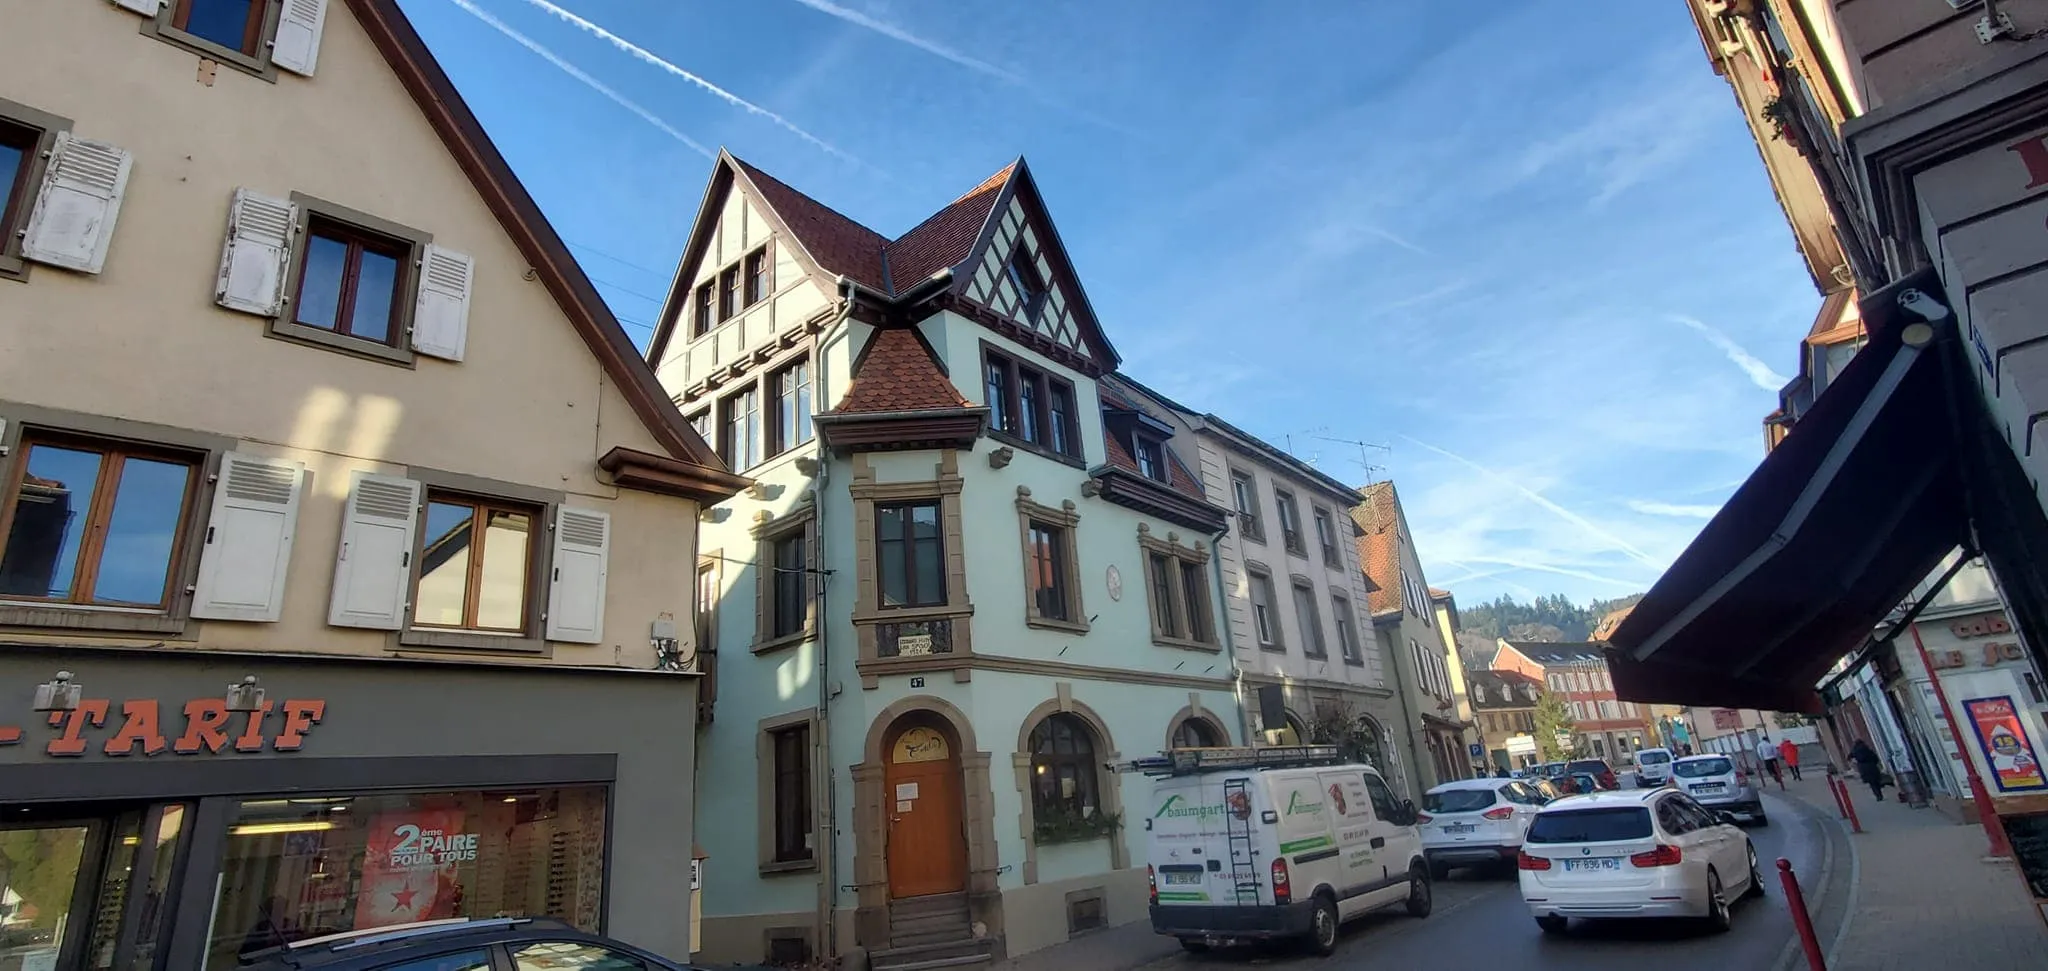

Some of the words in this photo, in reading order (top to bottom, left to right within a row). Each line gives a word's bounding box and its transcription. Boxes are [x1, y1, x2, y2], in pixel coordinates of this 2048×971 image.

[911, 678, 923, 687] 47
[1167, 803, 1226, 818] baumgart
[420, 833, 479, 853] PAIRE
[391, 852, 434, 867] POUR
[437, 850, 477, 862] TOUS
